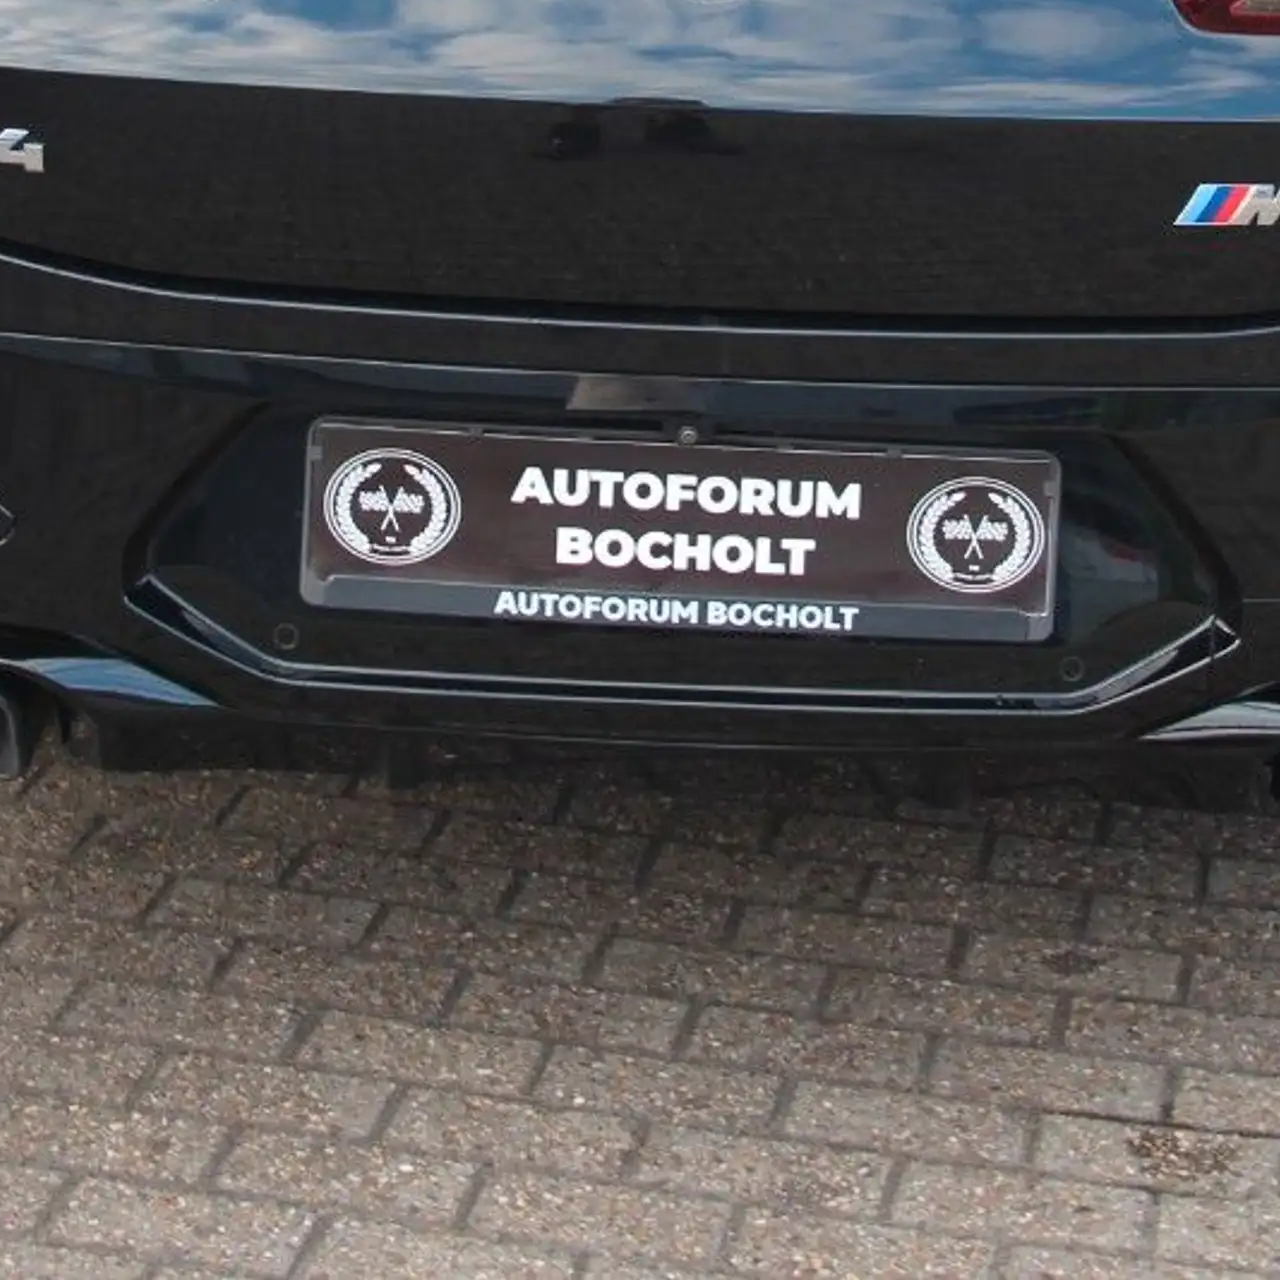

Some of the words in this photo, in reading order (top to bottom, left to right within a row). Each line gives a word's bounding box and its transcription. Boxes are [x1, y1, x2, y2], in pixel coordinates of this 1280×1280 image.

[511, 467, 862, 519] AUTOFORUM
[555, 527, 816, 575] BOCHOLT
[493, 591, 699, 624] AUTOFORUM
[706, 601, 859, 631] BOCHOLT
